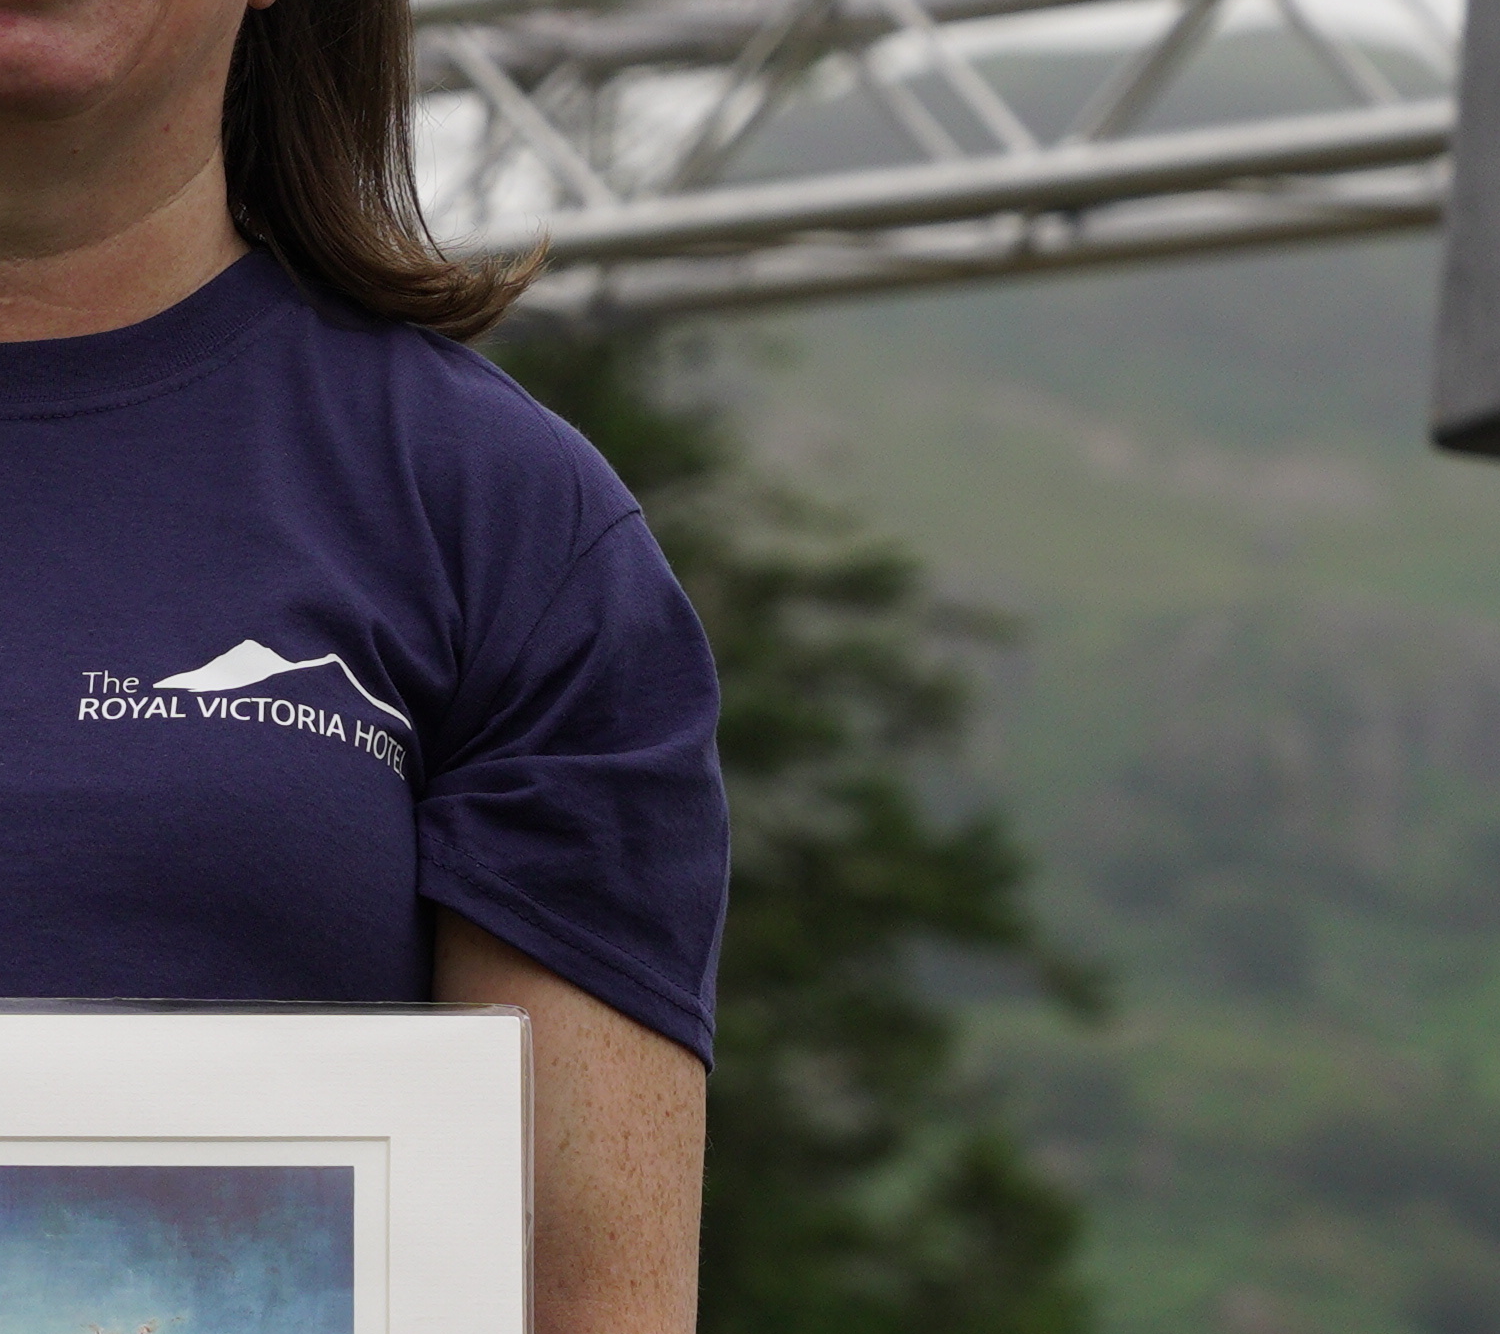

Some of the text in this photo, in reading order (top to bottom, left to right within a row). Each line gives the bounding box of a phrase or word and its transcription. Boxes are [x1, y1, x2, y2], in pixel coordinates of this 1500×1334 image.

[82, 670, 140, 694] The
[77, 696, 186, 721] ROYAL
[197, 696, 347, 742] VICTORIA
